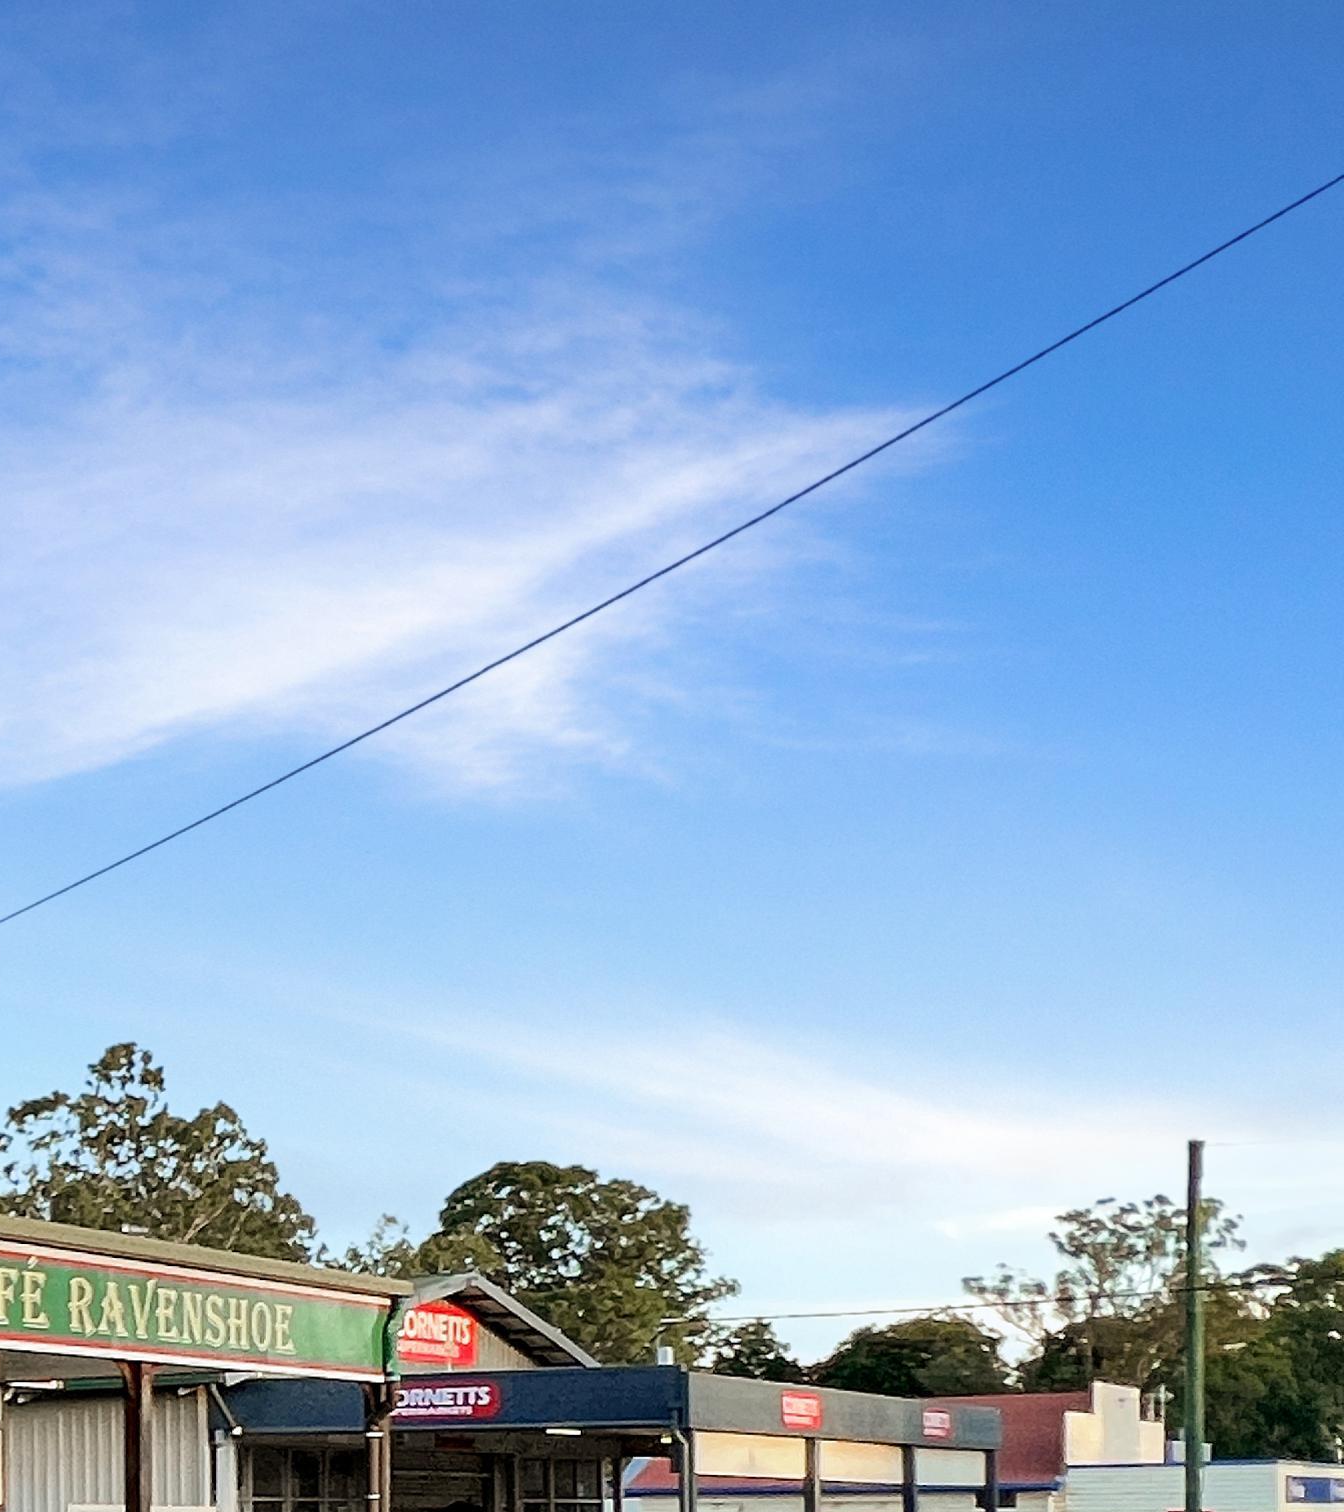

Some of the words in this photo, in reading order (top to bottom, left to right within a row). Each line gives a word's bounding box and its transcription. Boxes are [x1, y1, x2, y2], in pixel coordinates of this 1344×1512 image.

[67, 1274, 298, 1356] RAVENSHOE
[397, 1309, 472, 1346] ORNETTS
[394, 1386, 492, 1407] ORNETTS
